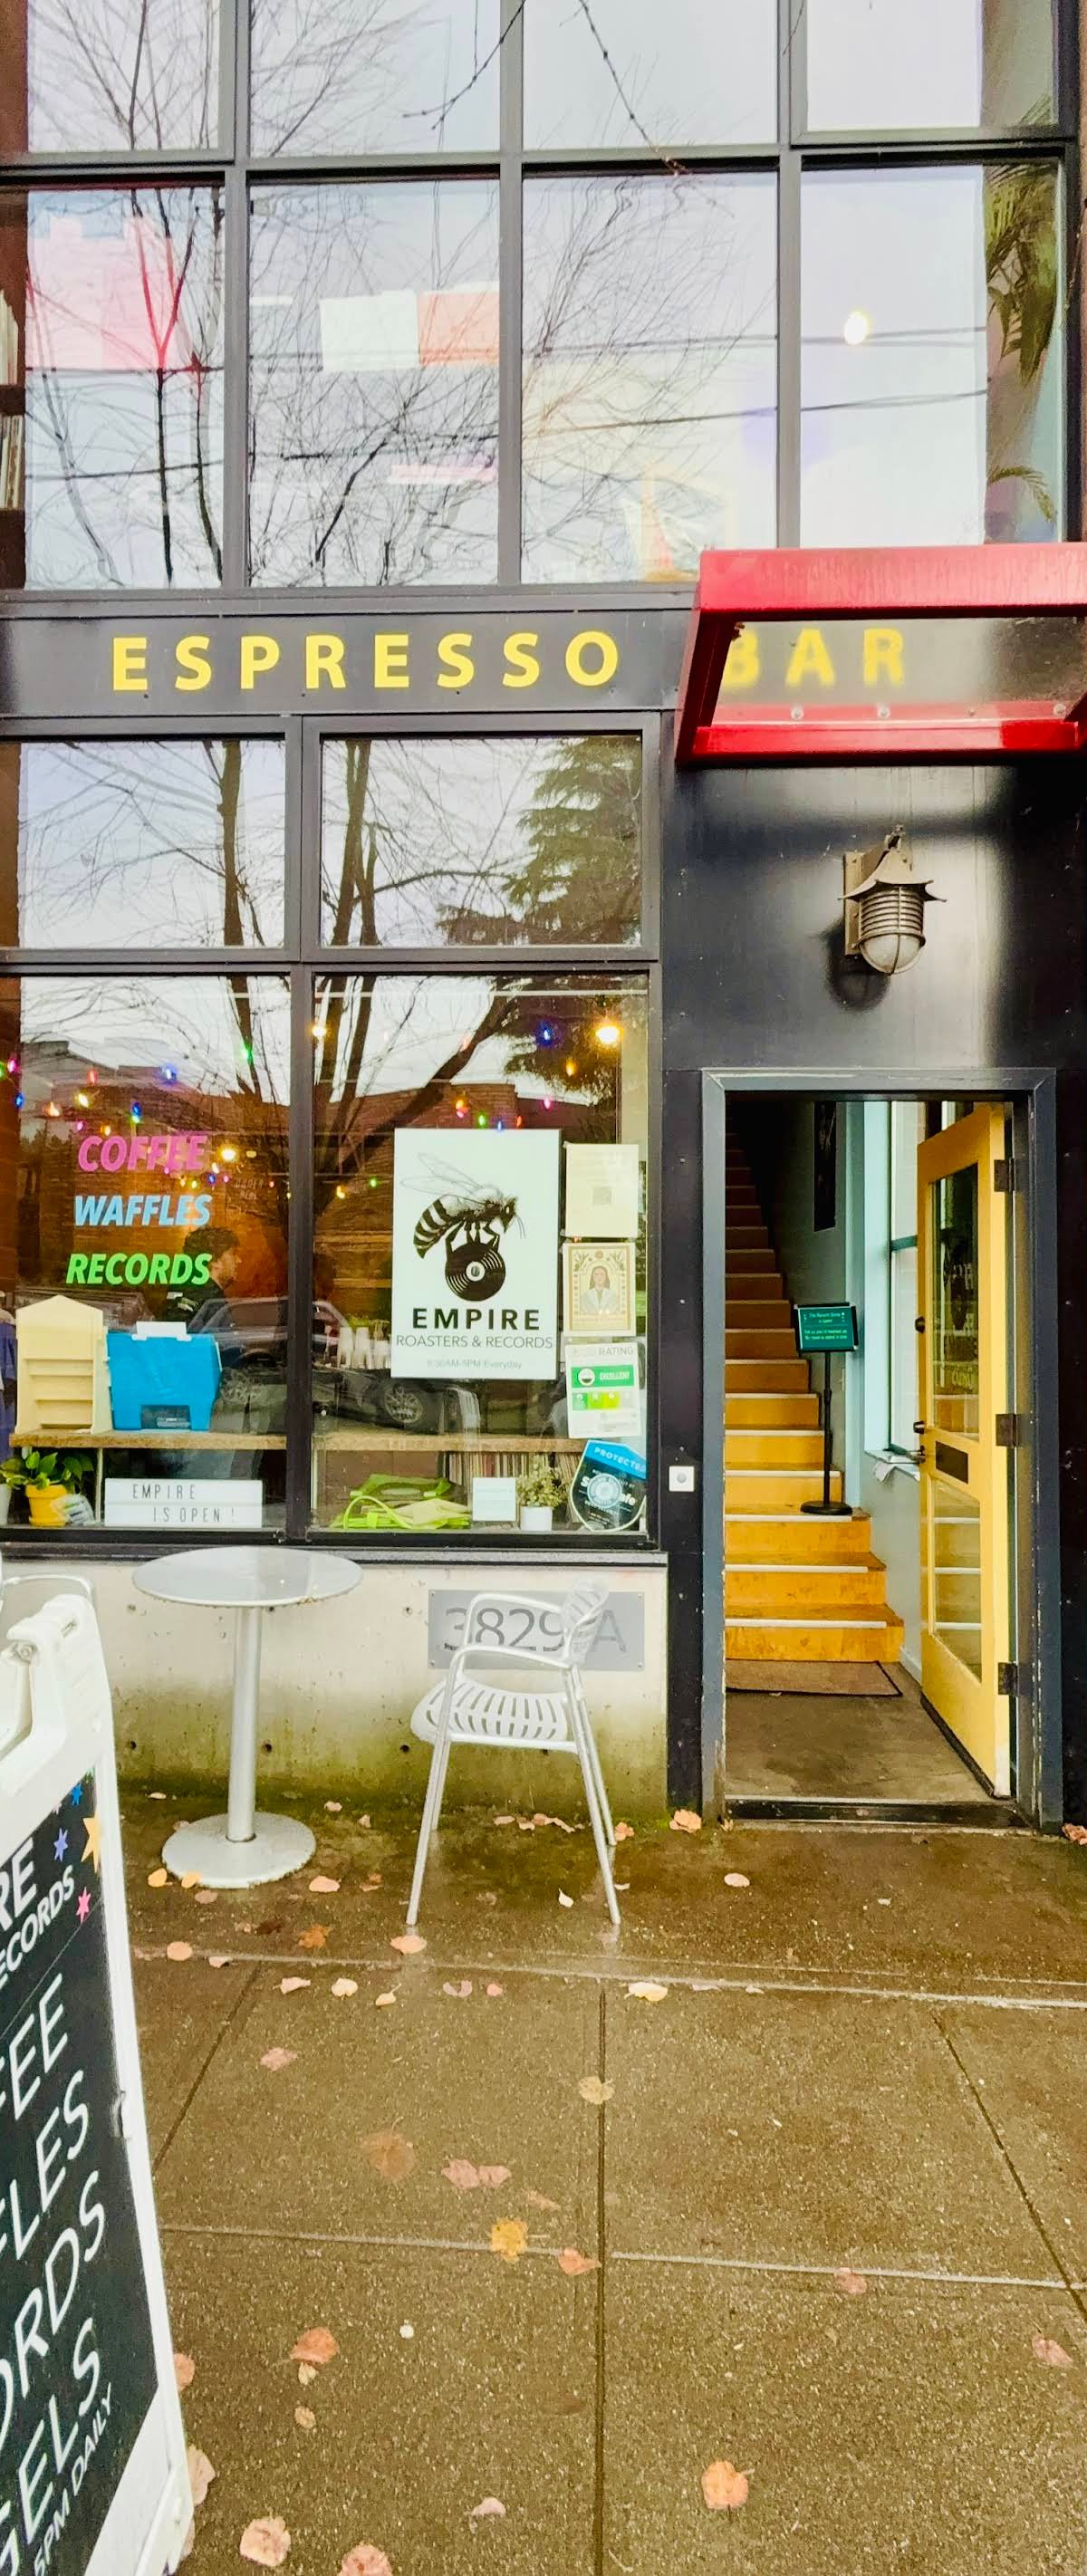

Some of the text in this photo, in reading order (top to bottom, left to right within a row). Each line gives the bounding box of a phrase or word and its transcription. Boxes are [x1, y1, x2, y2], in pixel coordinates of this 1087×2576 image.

[112, 627, 904, 692] ESPRESSO BAR
[78, 1135, 208, 1172] COFFEE
[75, 1195, 213, 1226] WAFFLES
[65, 1253, 213, 1285] RECORDS
[413, 1307, 540, 1331] EMPIRE
[396, 1335, 553, 1349] ROASTERS & RECORDS
[599, 1347, 634, 1356] RATING
[484, 1360, 523, 1370] Everyday
[132, 1484, 197, 1500] EMPIRE
[153, 1507, 170, 1523] IS
[591, 1609, 627, 1653] A
[0, 1973, 68, 2121] EE
[0, 2070, 89, 2262] LES
[72, 2381, 111, 2496] DAILY
